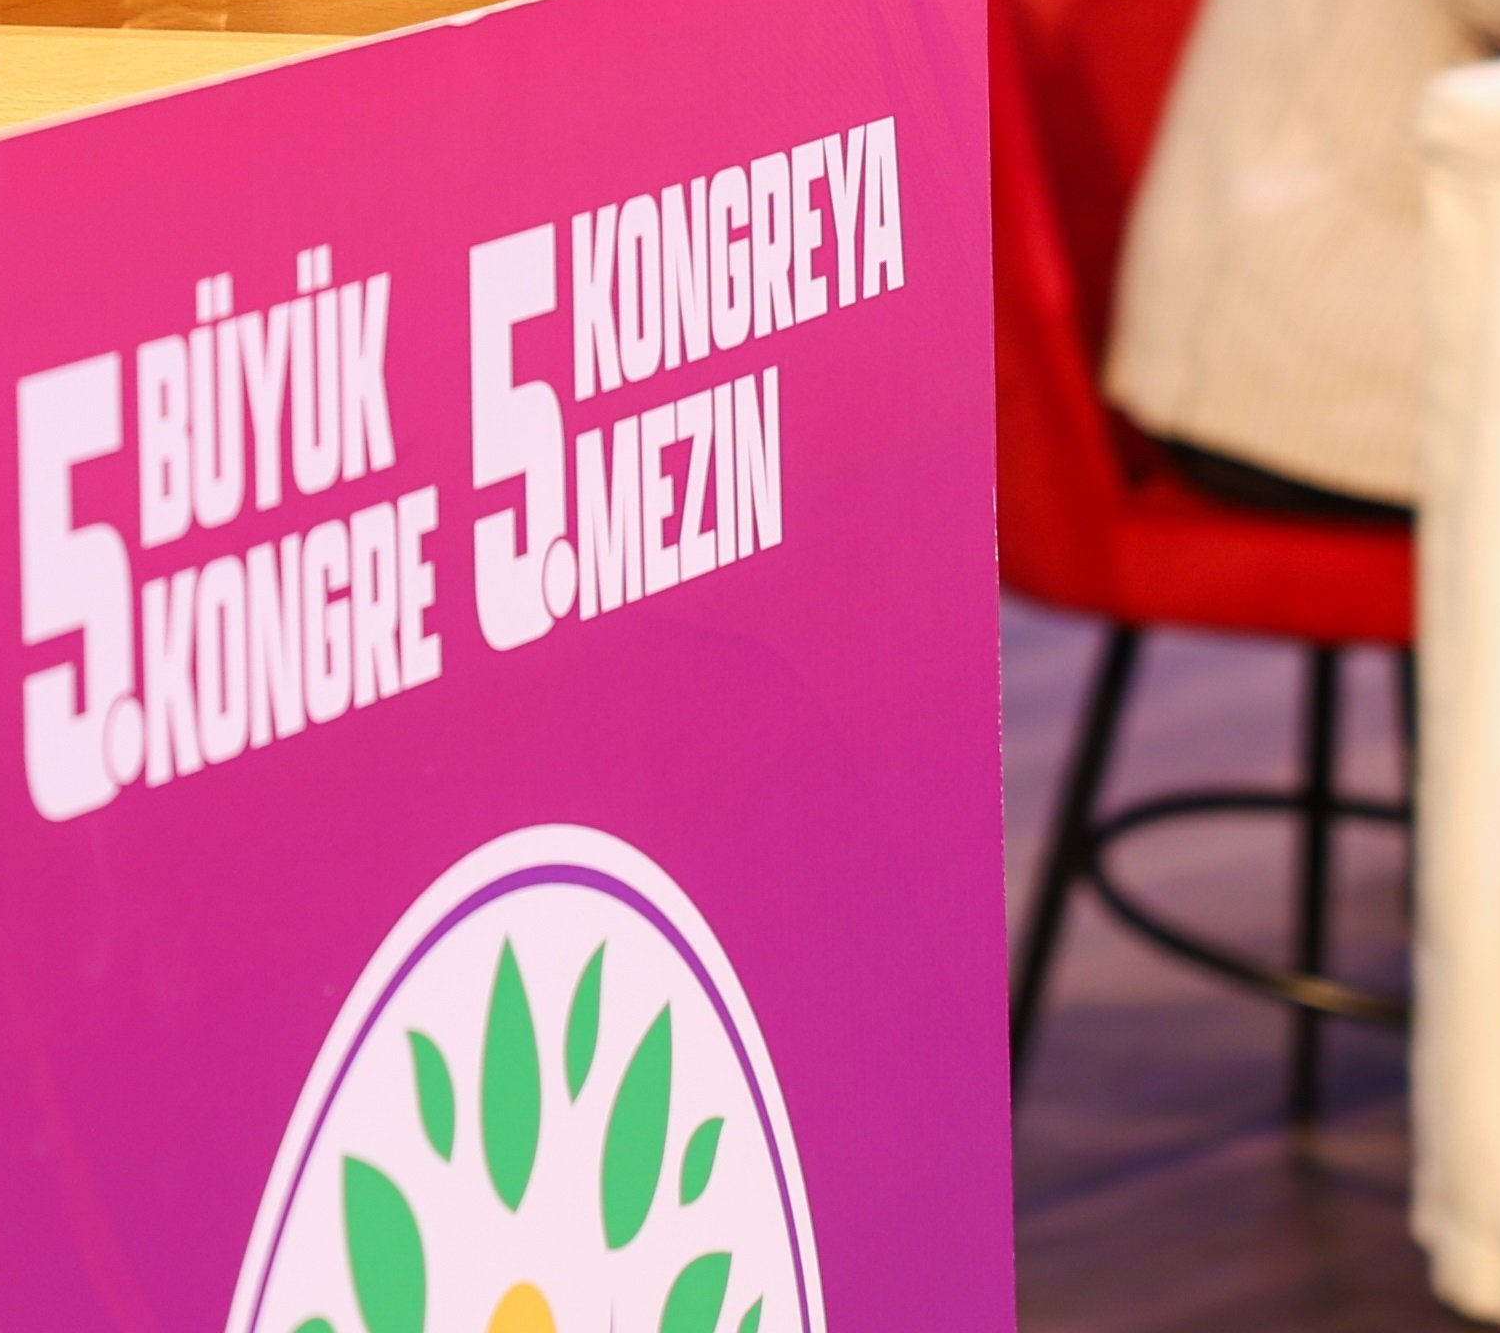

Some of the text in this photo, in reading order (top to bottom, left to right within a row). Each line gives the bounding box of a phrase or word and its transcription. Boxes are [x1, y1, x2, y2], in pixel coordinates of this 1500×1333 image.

[136, 243, 396, 551] BÜYÜK
[571, 114, 904, 403] KONGREYA
[141, 484, 441, 790] KONGRE
[575, 364, 783, 623] MEZIN
